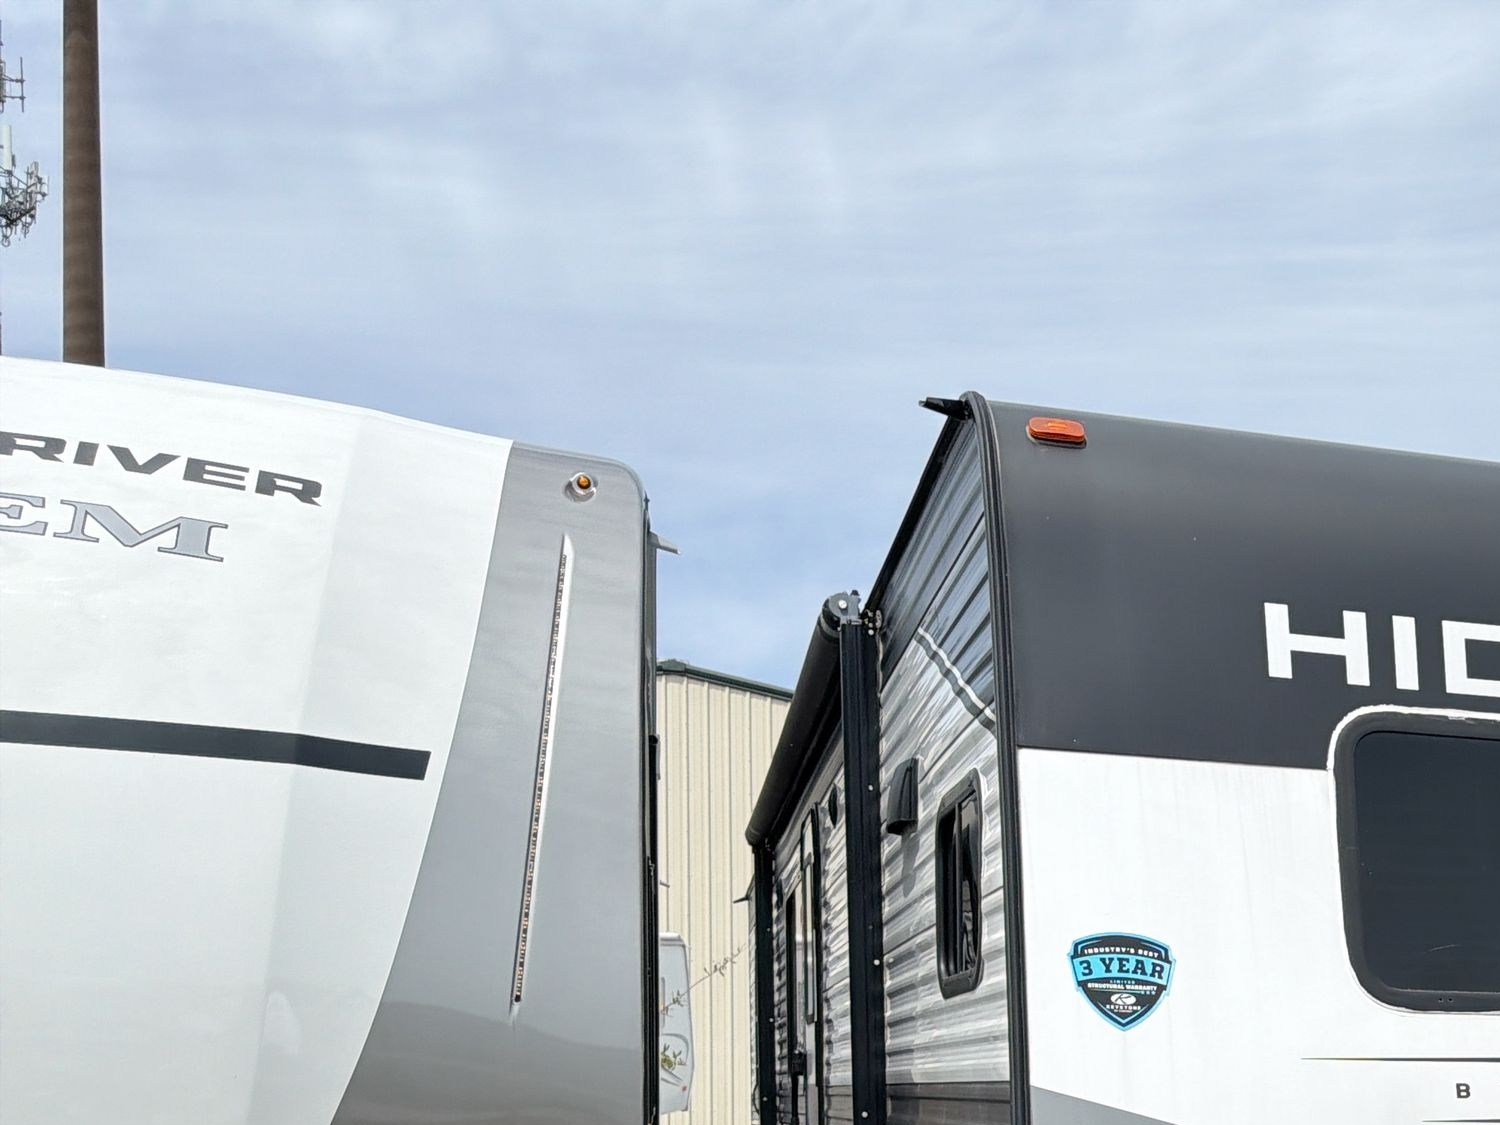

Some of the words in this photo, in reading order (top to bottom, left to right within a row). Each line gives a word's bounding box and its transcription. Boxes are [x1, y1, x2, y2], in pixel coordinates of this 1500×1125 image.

[0, 431, 322, 507] RIVER
[1138, 948, 1159, 958] BEST
[1079, 960, 1094, 976] 3
[1099, 957, 1165, 980] YEAR
